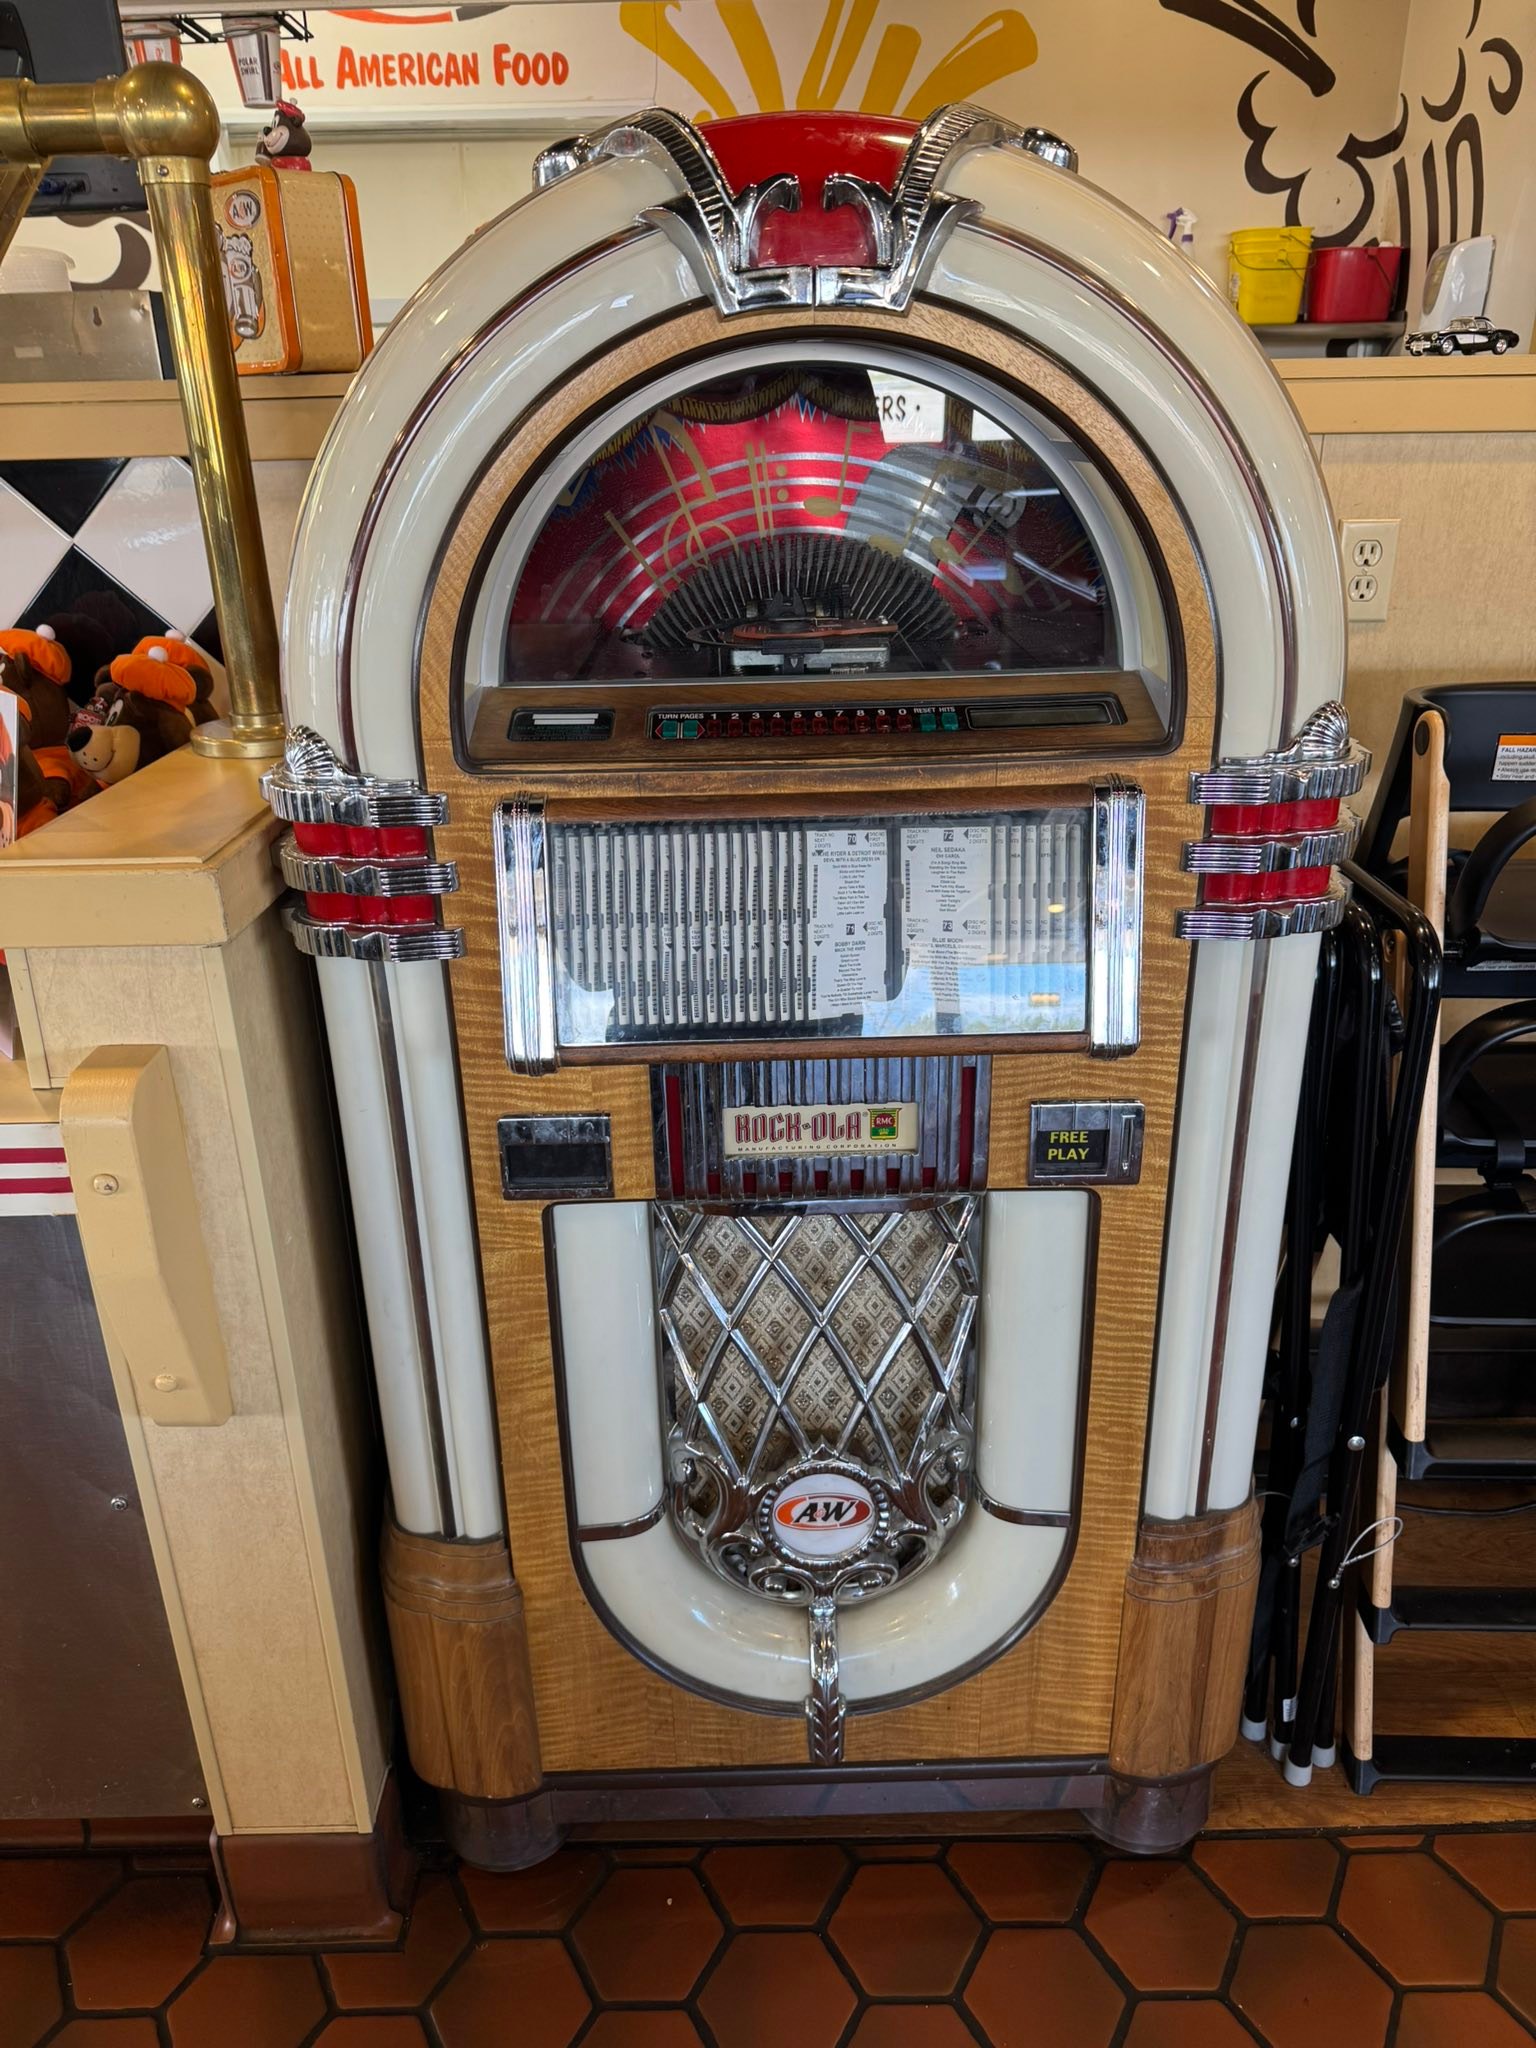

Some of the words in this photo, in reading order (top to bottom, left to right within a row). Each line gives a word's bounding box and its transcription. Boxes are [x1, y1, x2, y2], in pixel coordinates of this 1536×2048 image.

[238, 56, 258, 67] POLAR
[280, 48, 324, 89] ALL
[337, 46, 480, 89] AMERICAN
[494, 44, 569, 87] FOOD
[241, 66, 260, 76] SWIRL
[232, 200, 253, 220] A&W
[814, 710, 823, 718] 6
[856, 709, 865, 717] 8
[898, 708, 907, 716] 0
[875, 1116, 894, 1126] RMC
[1050, 1131, 1089, 1144] FREE
[1047, 1148, 1090, 1160] PLAY
